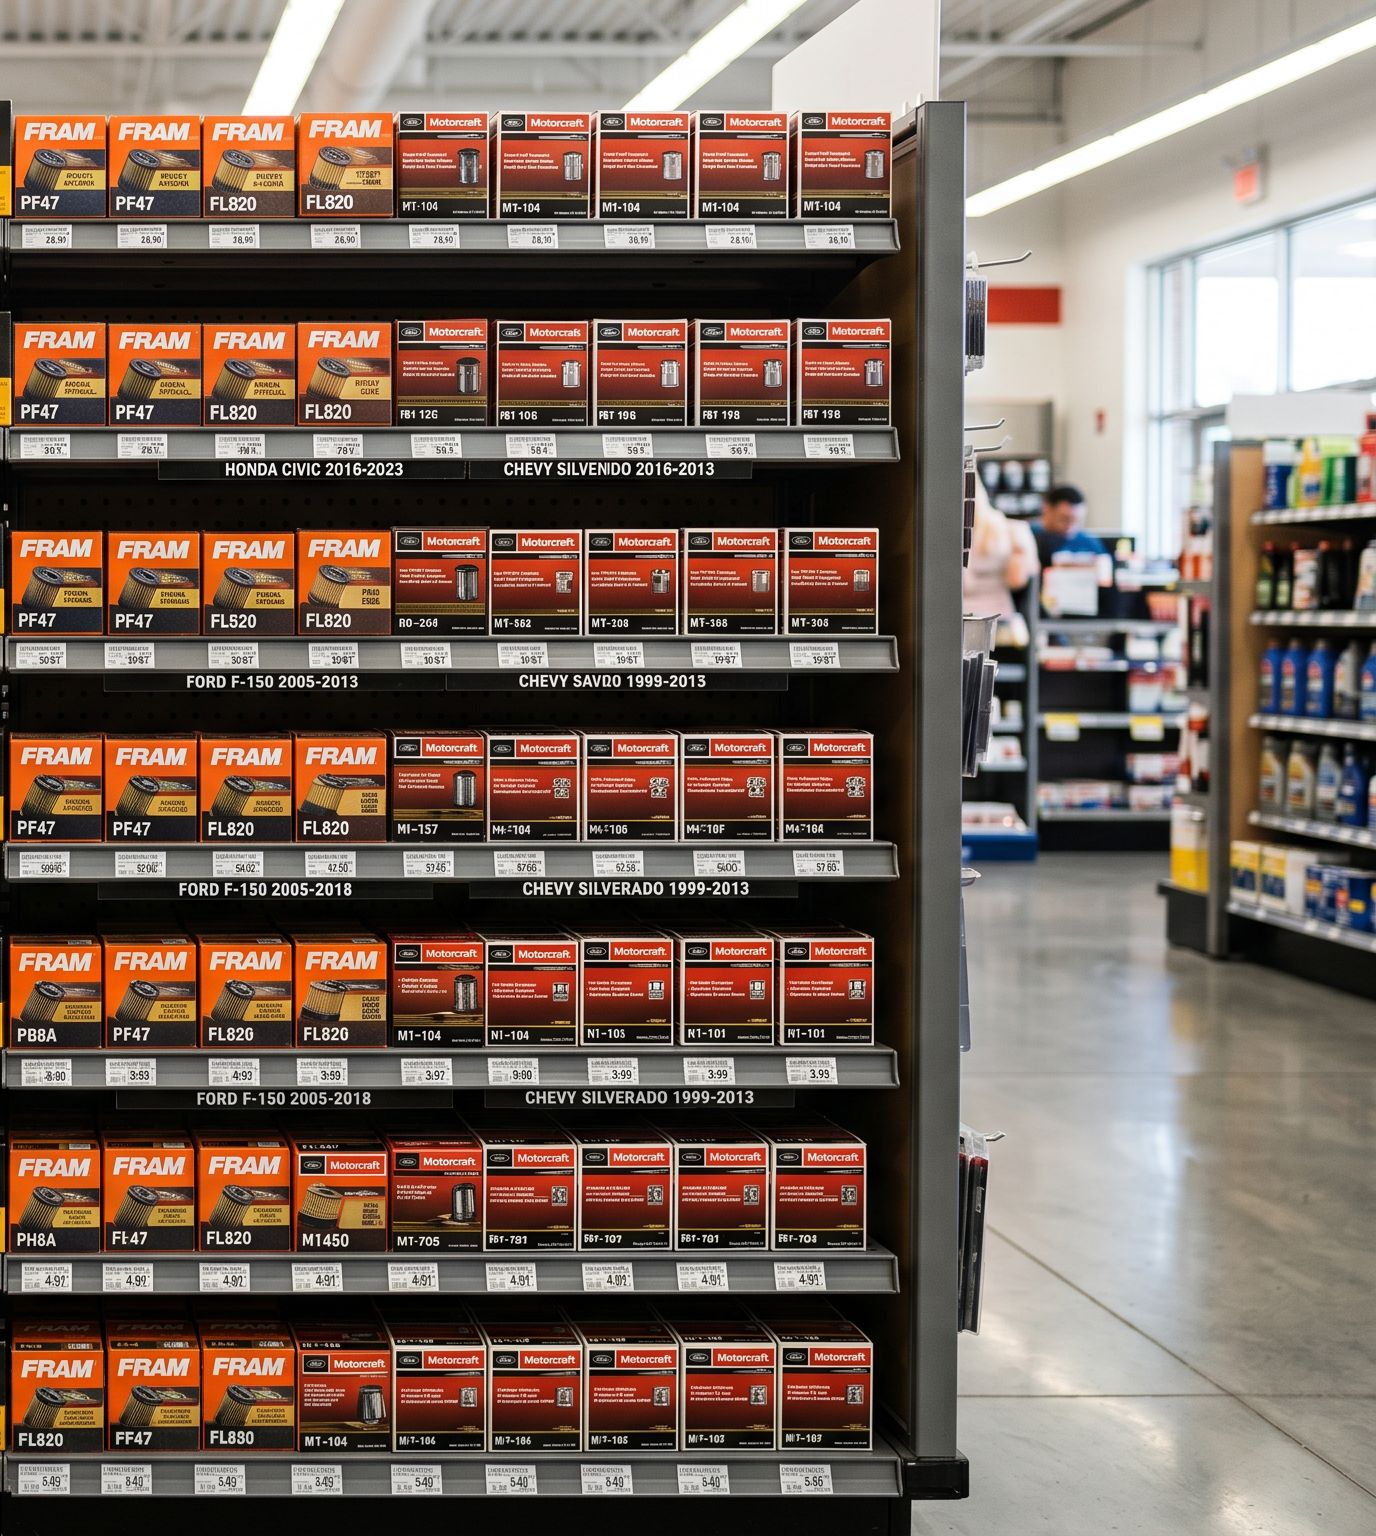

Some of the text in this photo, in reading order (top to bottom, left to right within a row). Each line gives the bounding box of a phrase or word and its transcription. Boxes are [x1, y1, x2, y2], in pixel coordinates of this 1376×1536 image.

[308, 119, 383, 139] FRAM
[429, 117, 483, 127] Motorcraft
[630, 117, 684, 127] Motorcraft
[23, 122, 96, 141] FRAM
[20, 195, 60, 210] PF47
[306, 194, 354, 210] FL820
[307, 330, 381, 348] FRAM
[627, 327, 681, 337] Motorcraft
[730, 327, 784, 337] Motorcraft
[23, 331, 96, 349] FRAM
[115, 404, 155, 420] PF47
[210, 404, 257, 421] FL820
[225, 462, 404, 477] HONDA CIVIC 2016-2023
[503, 462, 554, 477] CHEVY
[635, 461, 715, 476] 2016-2013
[19, 539, 93, 558] FRAM
[307, 539, 381, 558] FRAM
[427, 536, 481, 546] Motorcraft
[818, 536, 872, 546] Motorcraft
[115, 613, 154, 629] PF47
[210, 613, 257, 629] FL520
[186, 674, 359, 689] FORD F-150 2005-2013
[518, 674, 569, 688] CHEVY
[626, 674, 707, 688] 1999-2013
[425, 743, 478, 753] Motorcraft
[813, 742, 866, 752] Motorcraft
[20, 747, 93, 765] FRAM
[305, 746, 378, 766] FRAM
[17, 820, 56, 835] PF47
[303, 820, 350, 836] FL820
[179, 882, 353, 897] FORD F-150 2005-2018
[522, 881, 750, 896] CHEVY SILVERADO 1999-2013
[426, 949, 478, 958] Motorcraft
[715, 946, 767, 956] Motorcraft
[18, 952, 93, 972] FRAM
[305, 951, 378, 970] FRAM
[113, 1027, 151, 1042] PF47
[197, 1091, 372, 1106] FORD F-150 2005-2018
[525, 1090, 754, 1105] CHEVY SILVERADO 1999-2013
[423, 1157, 476, 1166] Motorcraft
[613, 1152, 665, 1162] Motorcraft
[18, 1158, 91, 1177] FRAM
[208, 1156, 282, 1175] FRAM
[330, 1160, 380, 1170] Motorcraft
[17, 1232, 57, 1247] PH8A
[206, 1230, 252, 1245] FL820
[717, 1353, 770, 1362] Motorcraft
[21, 1359, 94, 1378] FRAM
[212, 1357, 285, 1376] FRAM
[18, 1432, 64, 1447] FL820
